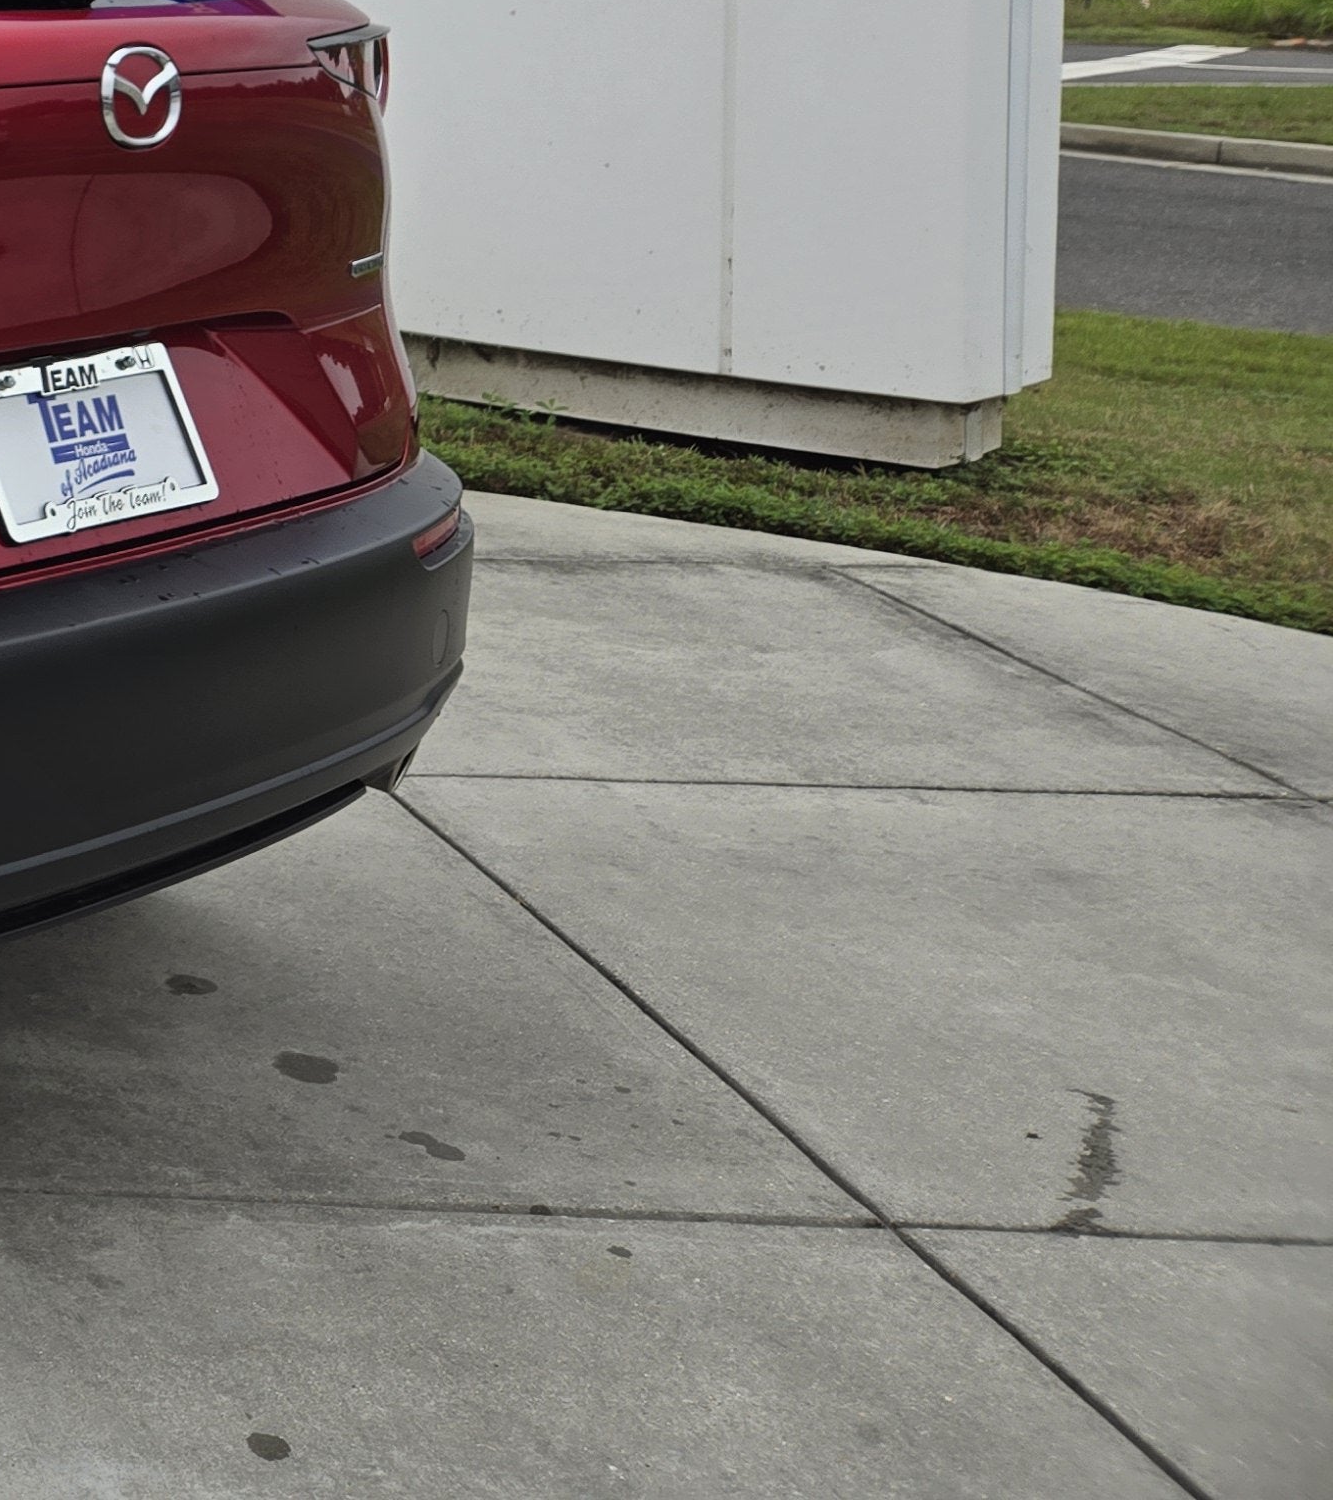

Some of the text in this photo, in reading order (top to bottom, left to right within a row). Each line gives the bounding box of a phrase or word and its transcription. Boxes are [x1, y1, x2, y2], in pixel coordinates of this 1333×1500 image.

[29, 355, 99, 393] TEAM
[26, 393, 125, 443] TEAM
[74, 440, 109, 457] Honda
[66, 500, 97, 530] Join
